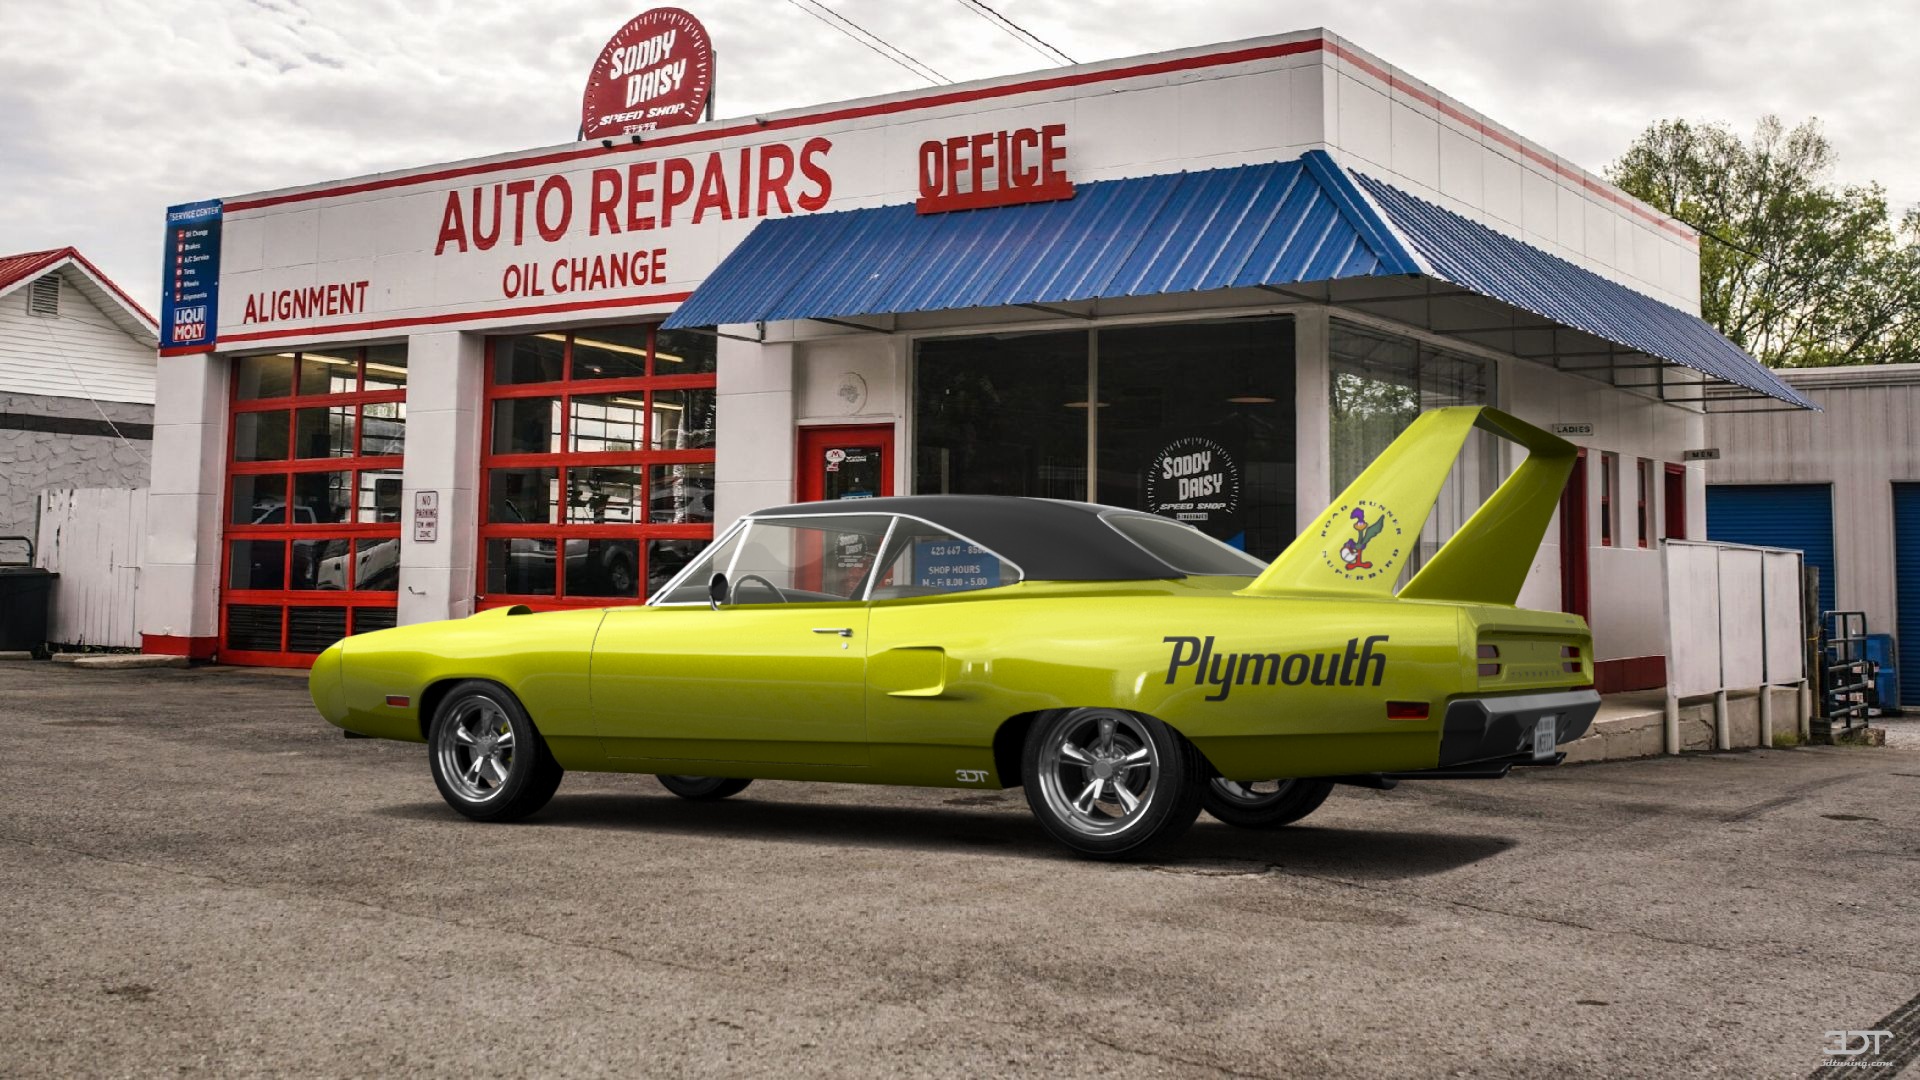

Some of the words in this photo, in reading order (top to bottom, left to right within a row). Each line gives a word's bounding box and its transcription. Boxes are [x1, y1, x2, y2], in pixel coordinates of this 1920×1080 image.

[610, 29, 676, 80] SODDY
[625, 58, 686, 108] DAISY
[600, 110, 644, 126] SPEED
[646, 102, 685, 118] SHOP
[918, 124, 1067, 198] OFFICE
[434, 174, 572, 256] AUTO
[590, 136, 832, 237] REPAIRS
[184, 255, 192, 263] A/C
[193, 254, 210, 262] Service
[502, 262, 544, 299] OIL
[552, 248, 667, 294] CHANGE
[183, 292, 208, 302] Alignments
[243, 281, 370, 324] ALIGNMENT
[176, 308, 204, 324] LIQUI
[174, 324, 205, 340] MOLY
[1162, 451, 1211, 480] SODDY
[1178, 473, 1223, 501] DAISY
[416, 508, 437, 518] PARKING
[422, 496, 431, 506] NO
[1321, 506, 1348, 537] ROAD
[1359, 500, 1401, 534] RUNNER
[930, 546, 944, 555] 423
[946, 546, 960, 555] 667
[928, 566, 950, 575] SHOP
[952, 565, 980, 574] HOURS
[1162, 635, 1390, 701] Plymouth
[955, 769, 989, 783] 3DT
